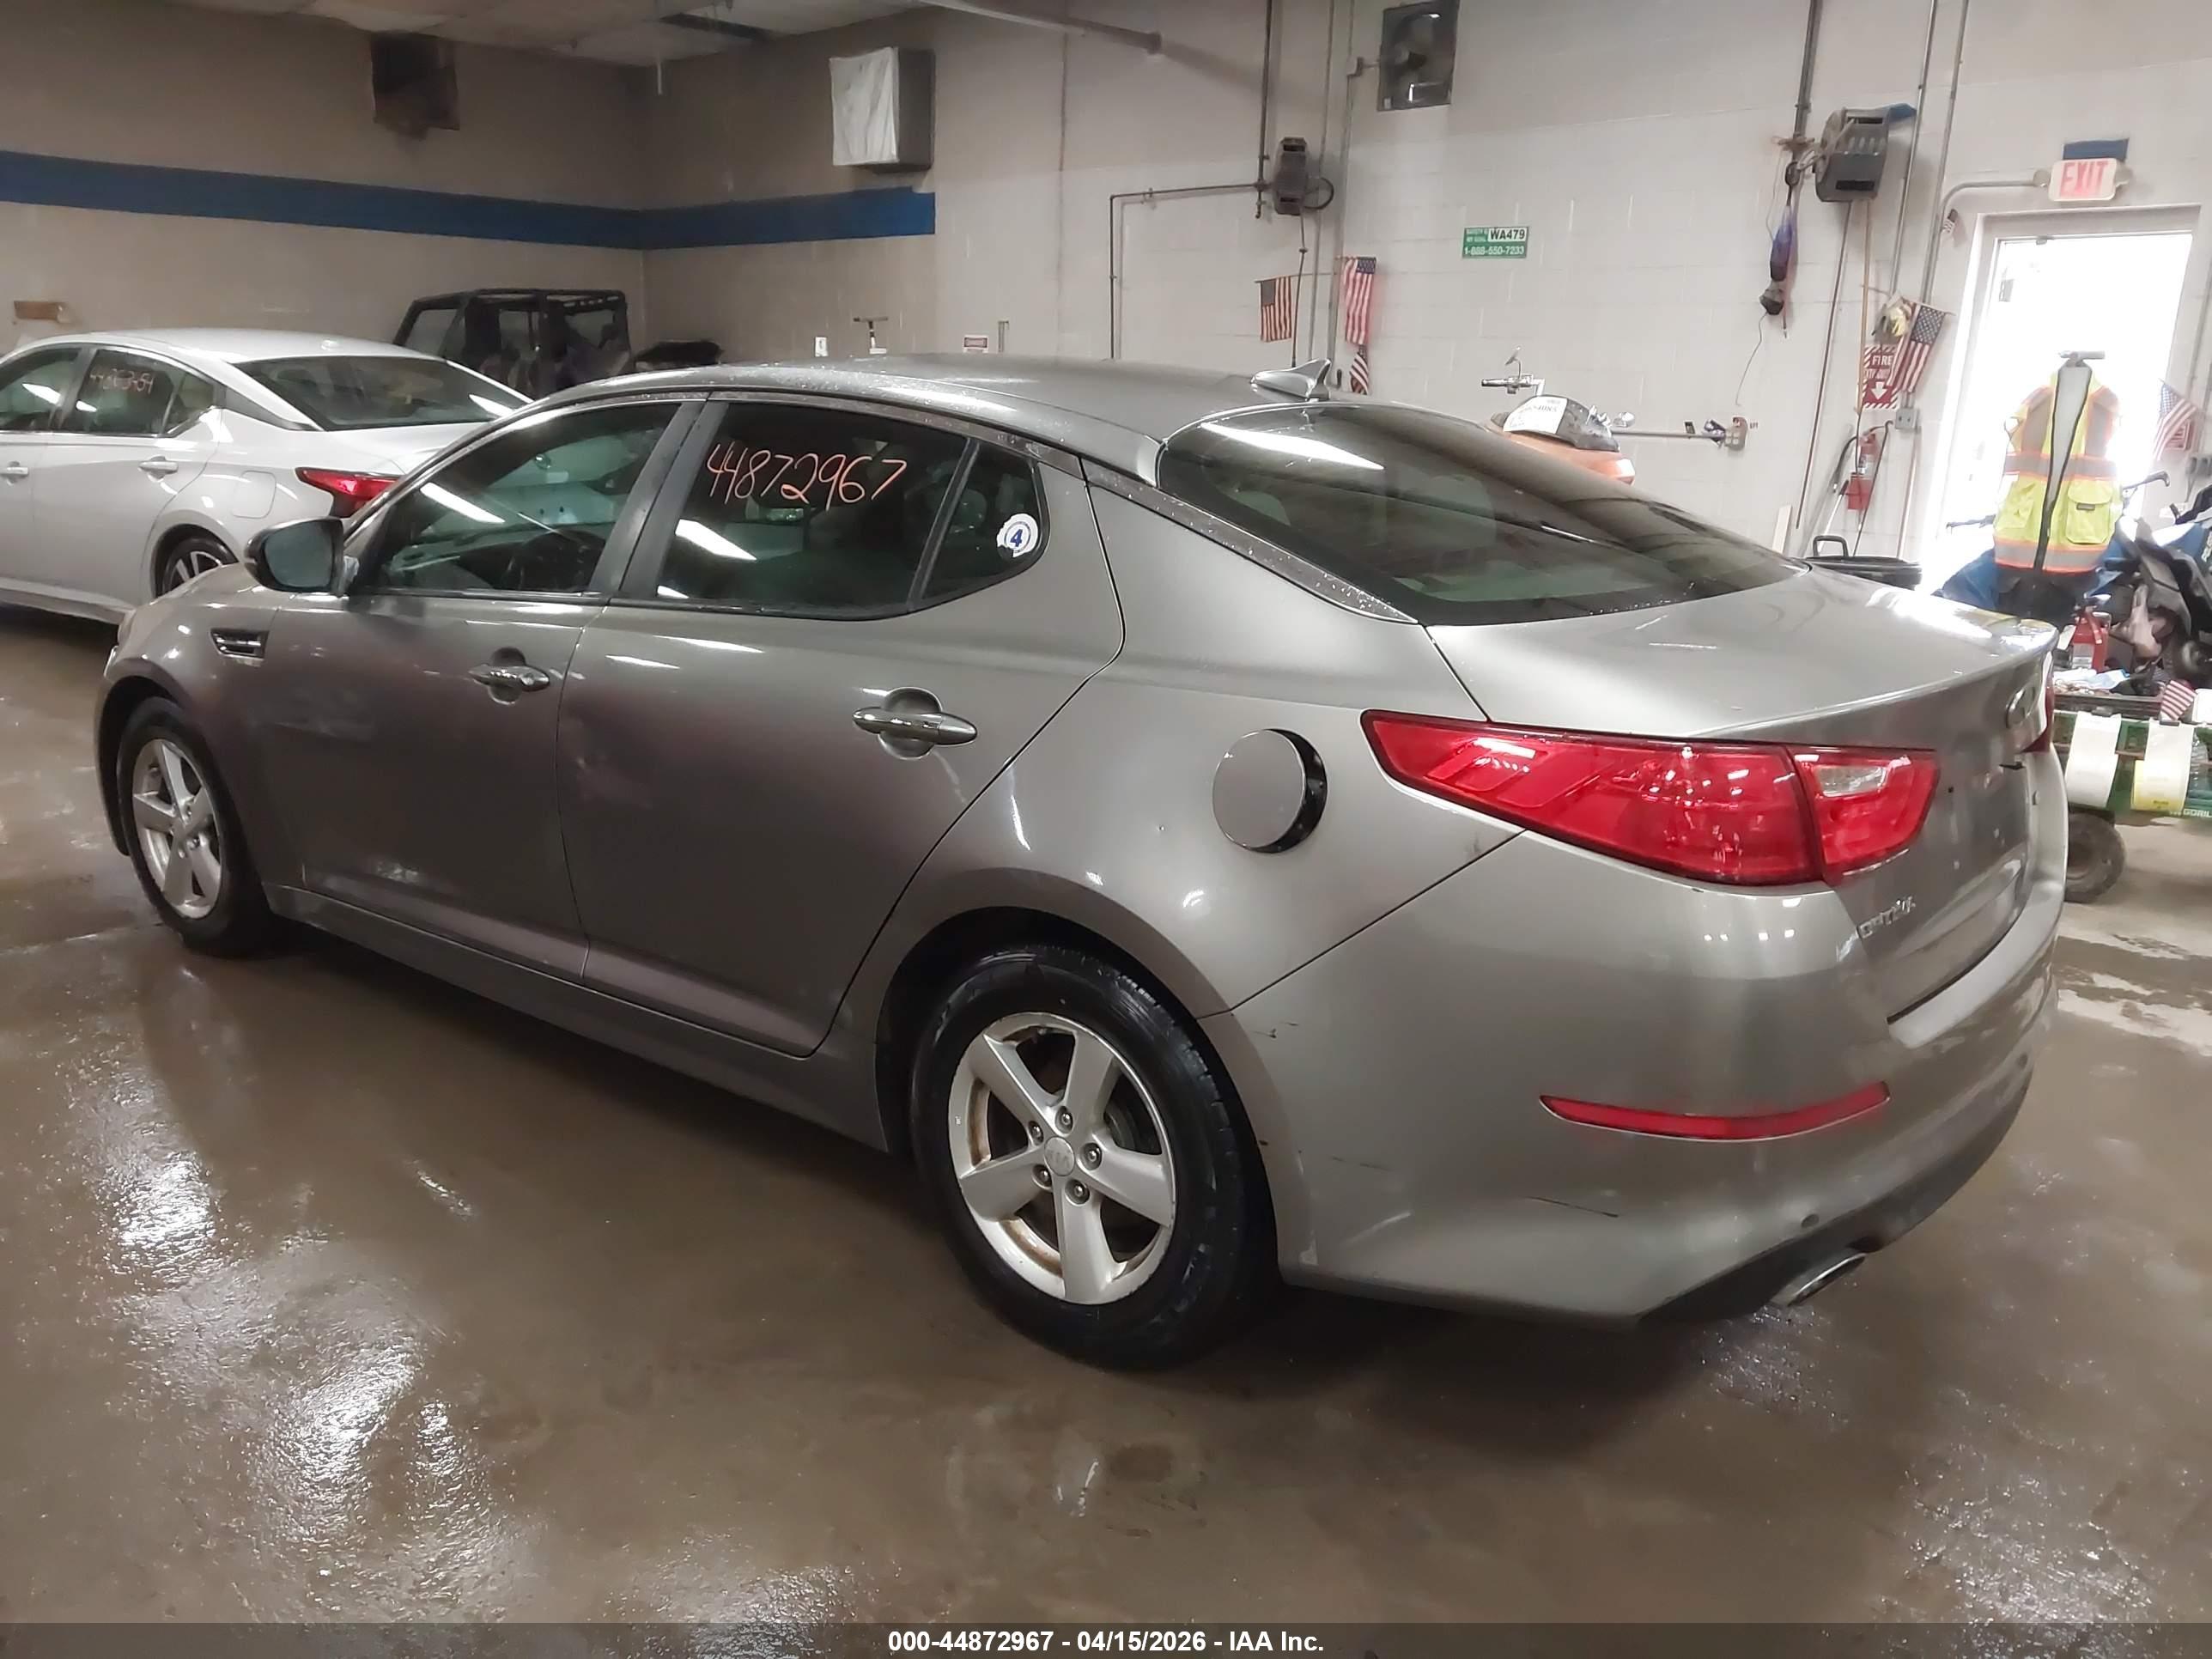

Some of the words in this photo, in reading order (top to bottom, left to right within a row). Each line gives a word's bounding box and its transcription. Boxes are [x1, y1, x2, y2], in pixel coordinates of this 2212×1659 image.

[2059, 161, 2108, 197] EXIT
[1490, 228, 1525, 240] WA479
[1872, 354, 1894, 366] FIRE
[707, 441, 908, 511] 44872967
[1010, 528, 1023, 547] 4
